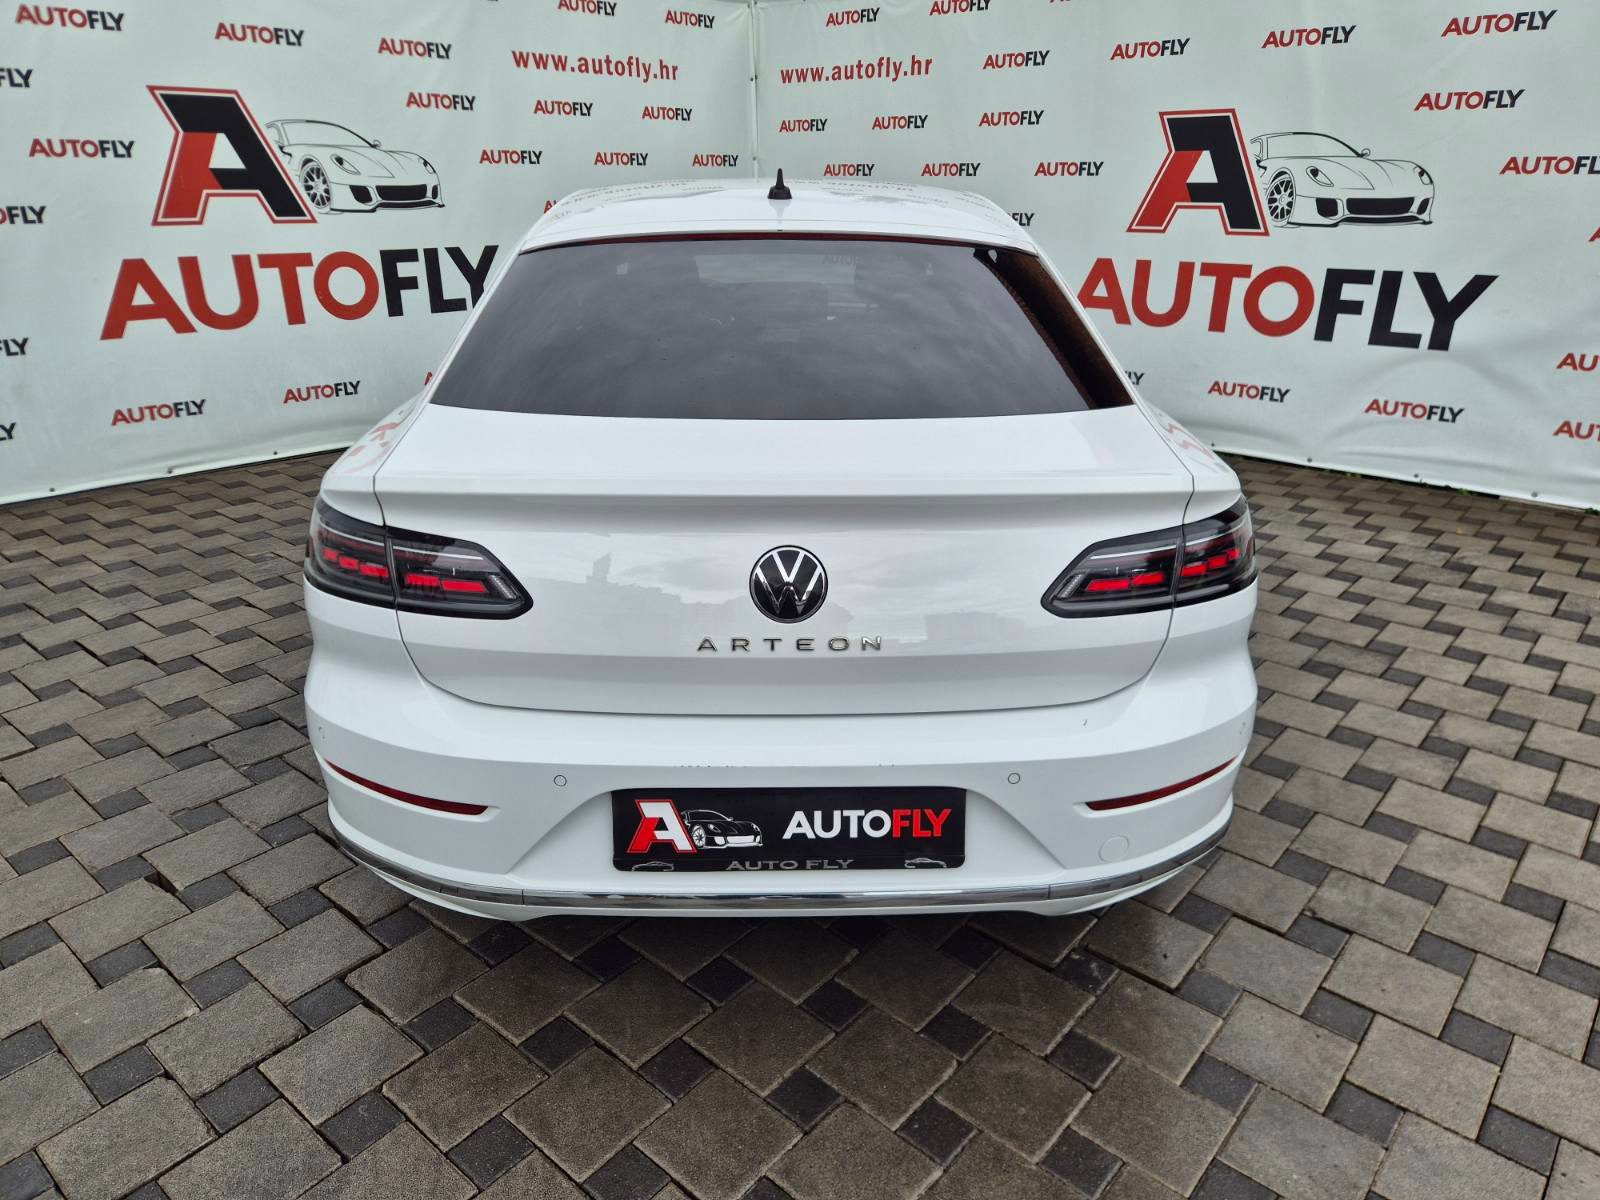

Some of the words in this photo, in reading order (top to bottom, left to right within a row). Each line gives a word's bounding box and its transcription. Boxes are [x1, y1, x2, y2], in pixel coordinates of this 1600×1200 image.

[15, 4, 125, 32] AUTOFLY
[558, 0, 617, 17] AUTOFLY
[826, 7, 881, 28] AUTOFLY
[930, 0, 990, 16] AUTOFLY
[665, 9, 716, 29] AUTOFLY
[1441, 9, 1558, 37] AUTOFLY
[214, 22, 305, 47] AUTOFLY
[1261, 25, 1357, 49] AUTOFLY
[378, 37, 452, 60] AUTOFLY
[1110, 38, 1191, 61] AUTOFLY
[512, 50, 679, 83] www.autofly.hr
[780, 55, 933, 84] www.autofly.hr
[983, 50, 1050, 70] AUTOFLY
[406, 92, 476, 111] AUTOFLY
[534, 100, 593, 117] AUTOFLY
[1414, 89, 1526, 112] AUTOFLY
[642, 106, 693, 122] AUTOFLY
[872, 115, 928, 130] AUTOFLY
[979, 110, 1045, 127] AUTOFLY
[779, 118, 828, 133] AUTOFLY
[29, 138, 135, 159] AUTOFLY
[480, 150, 542, 165] AUTOFLY
[594, 152, 649, 166] AUTOFLY
[693, 154, 739, 168] AUTOFLY
[1034, 161, 1104, 177] AUTOFLY
[824, 163, 875, 177] AUTOFLY
[921, 163, 981, 177] AUTOFLY
[100, 245, 499, 341] AUTOFLY
[1077, 257, 1500, 351] AUTOFLY
[283, 381, 361, 404] AUTOFLY
[1208, 381, 1291, 403] AUTOFLY
[111, 399, 207, 426] AUTOFLY
[1365, 398, 1465, 424] AUTOFLY
[697, 636, 883, 652] ARTEON
[782, 808, 952, 841] AUTOFLY
[725, 859, 799, 871] AUTO
[805, 859, 855, 870] FLY
